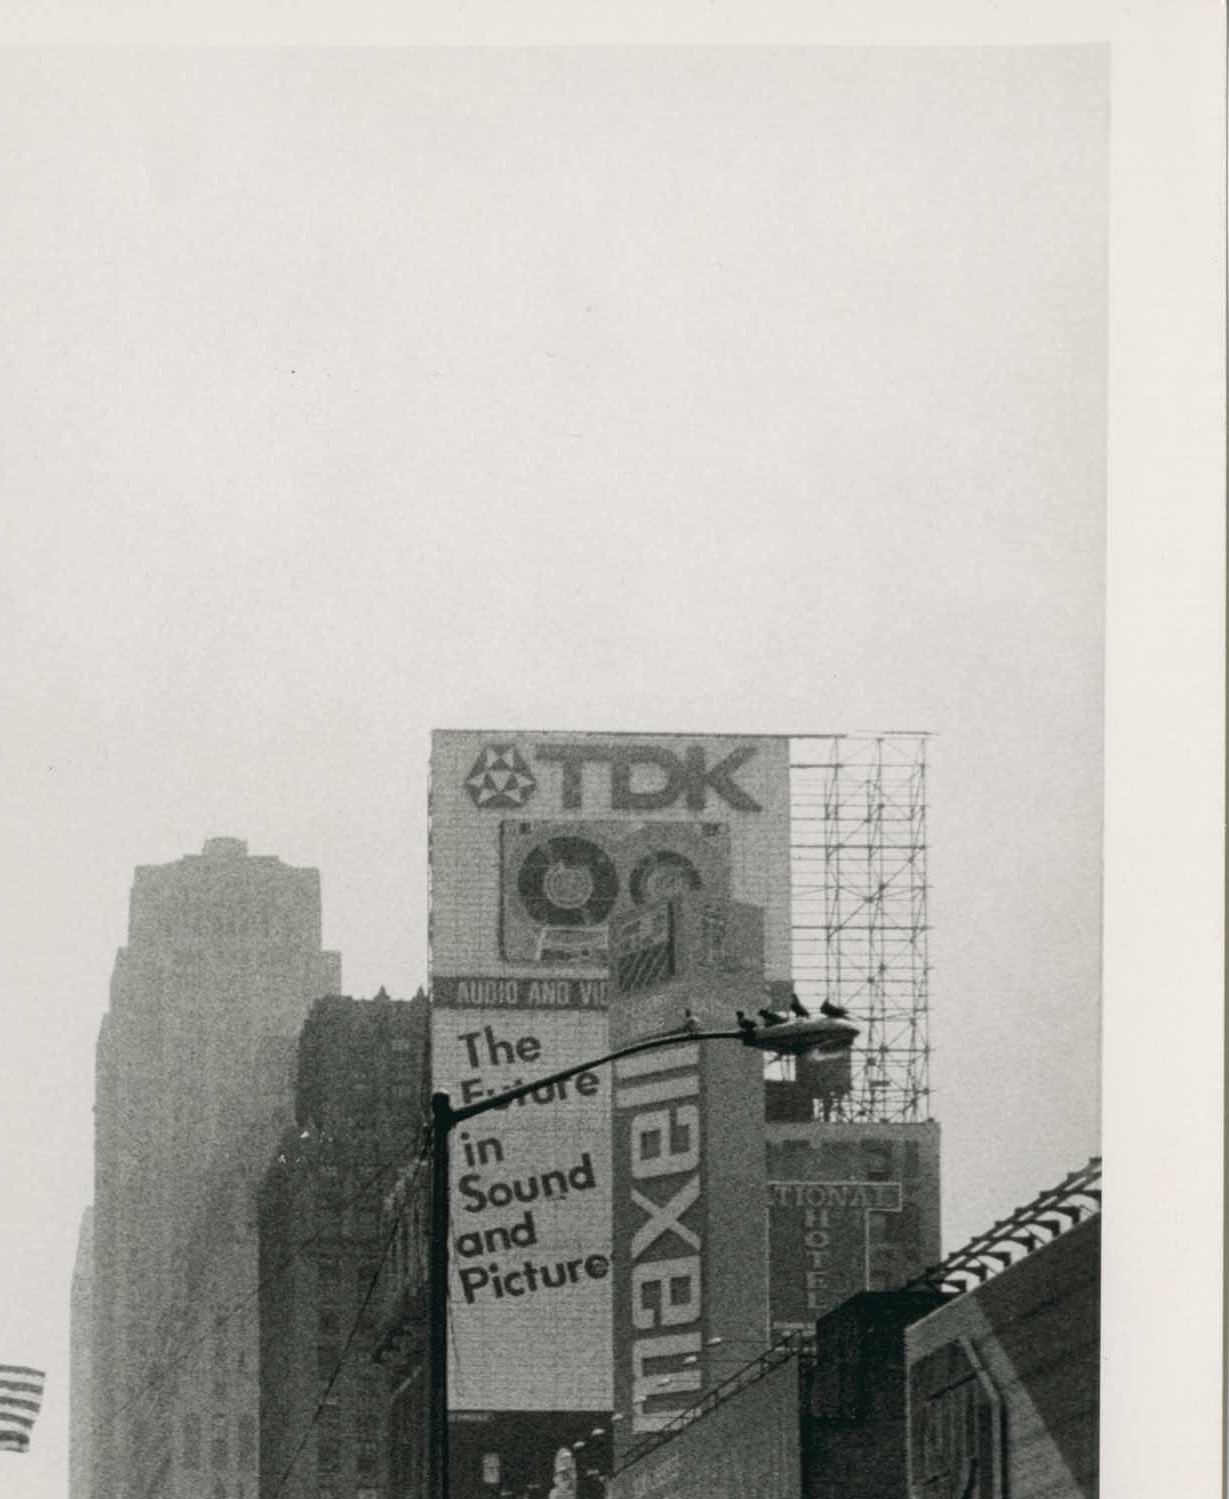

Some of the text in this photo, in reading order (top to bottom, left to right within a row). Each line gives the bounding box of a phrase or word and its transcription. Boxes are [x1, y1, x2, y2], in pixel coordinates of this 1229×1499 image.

[535, 744, 763, 813] TDK
[457, 981, 519, 1005] AUDIO
[530, 981, 569, 1005] AND
[457, 1025, 542, 1069] The
[460, 1072, 600, 1107] Fure
[460, 1130, 504, 1167] in
[457, 1154, 596, 1212] Sound
[768, 1183, 882, 1207] TIONAL
[457, 1212, 537, 1257] and
[616, 1042, 702, 1434] maxell
[459, 1253, 609, 1303] Picture
